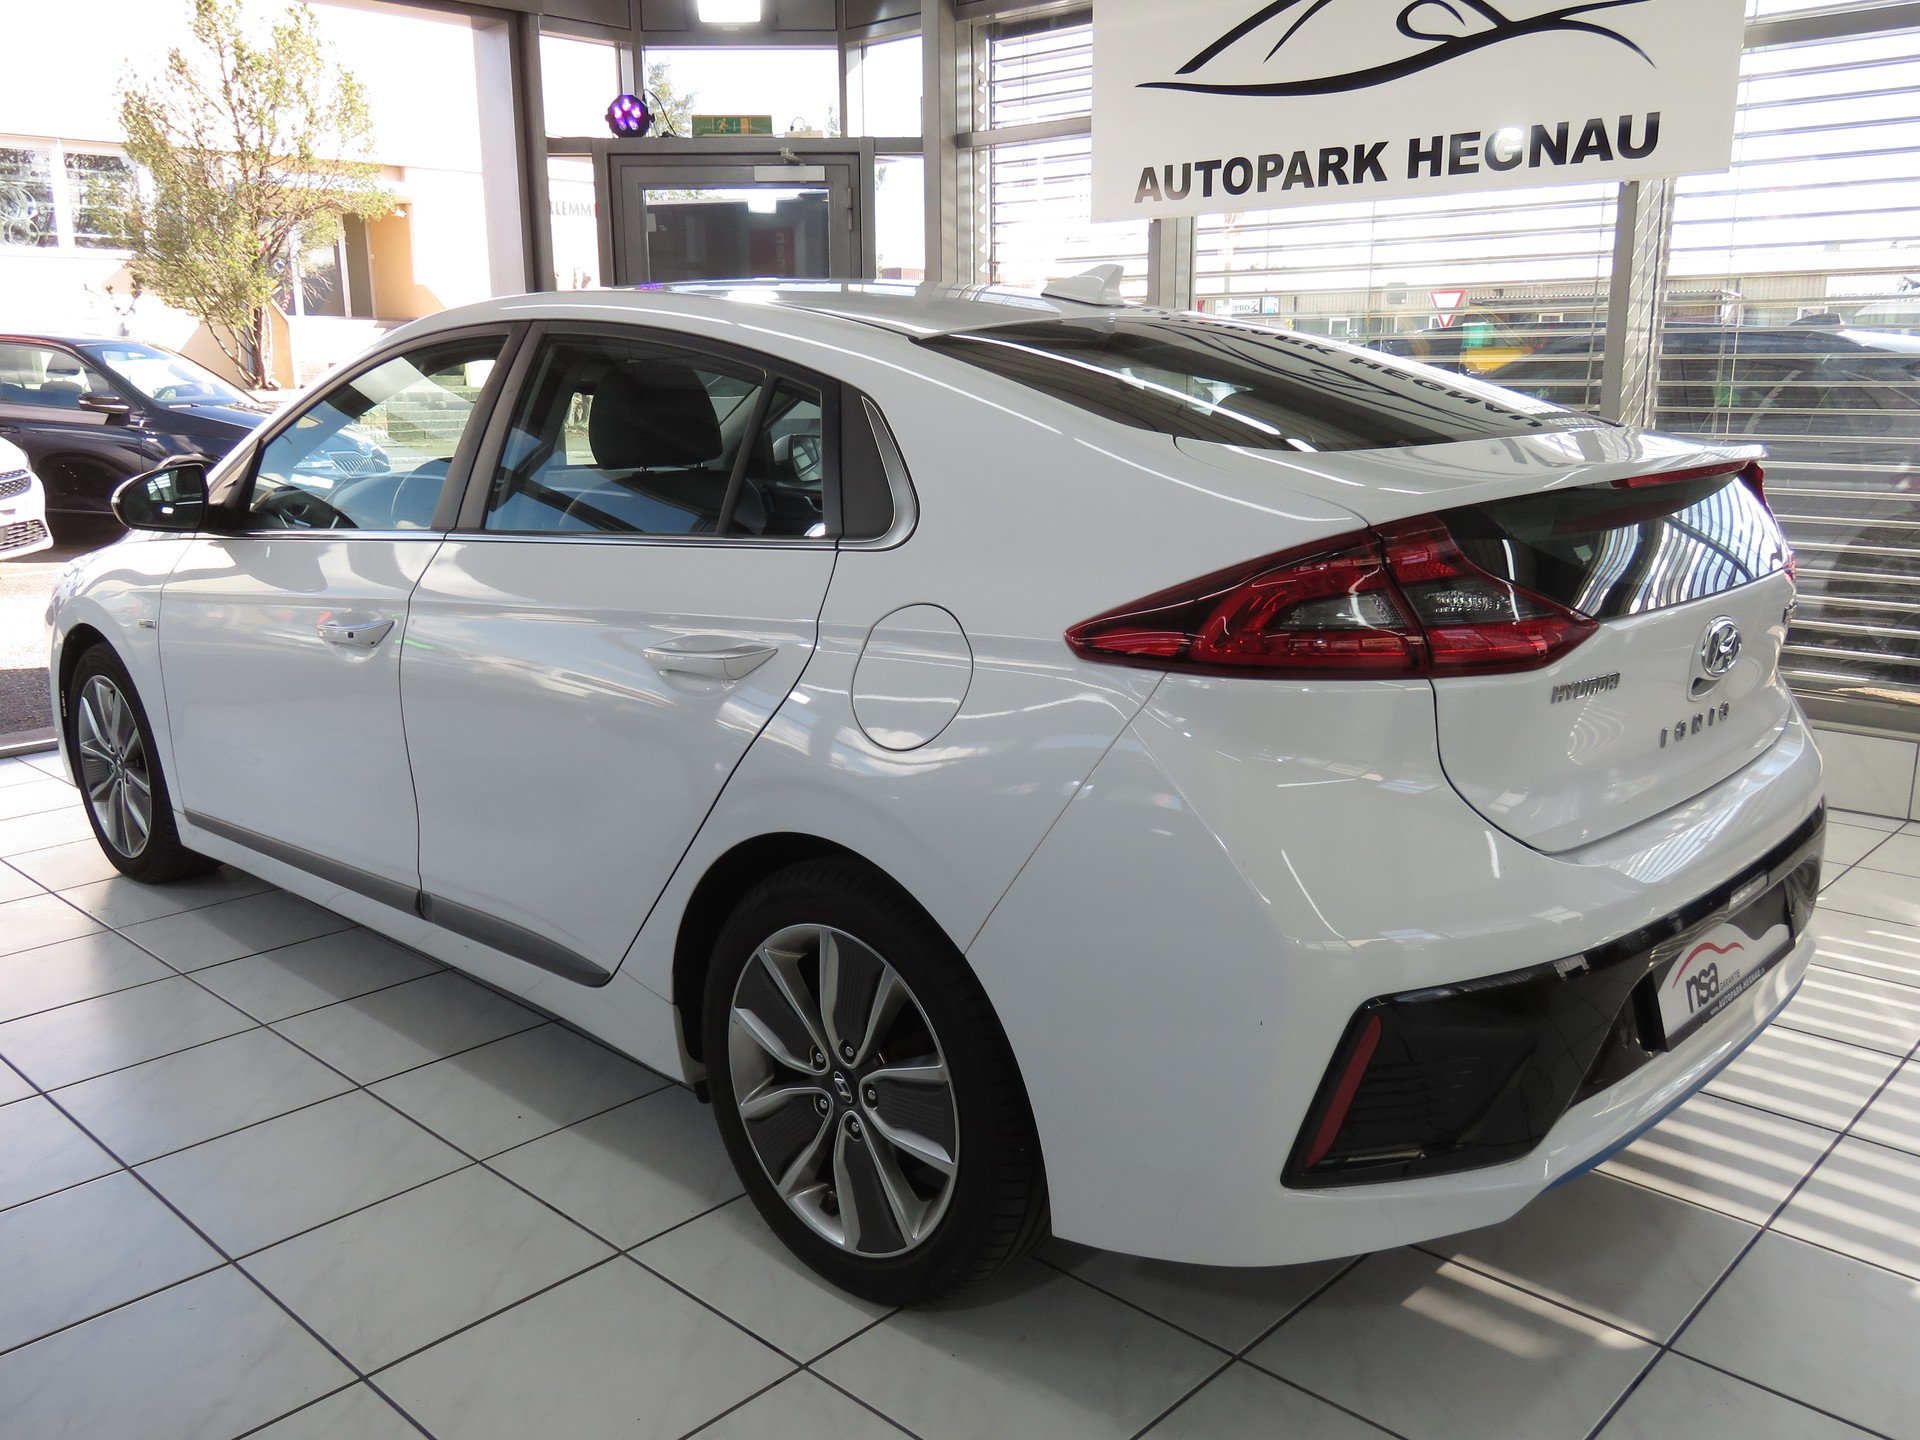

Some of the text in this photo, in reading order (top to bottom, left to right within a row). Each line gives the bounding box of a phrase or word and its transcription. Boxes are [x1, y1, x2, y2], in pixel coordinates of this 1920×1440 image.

[1134, 112, 1661, 203] AUTOPARK HEGNAU
[1550, 672, 1621, 704] HYUNDAI
[1686, 962, 1719, 1013] nsa
